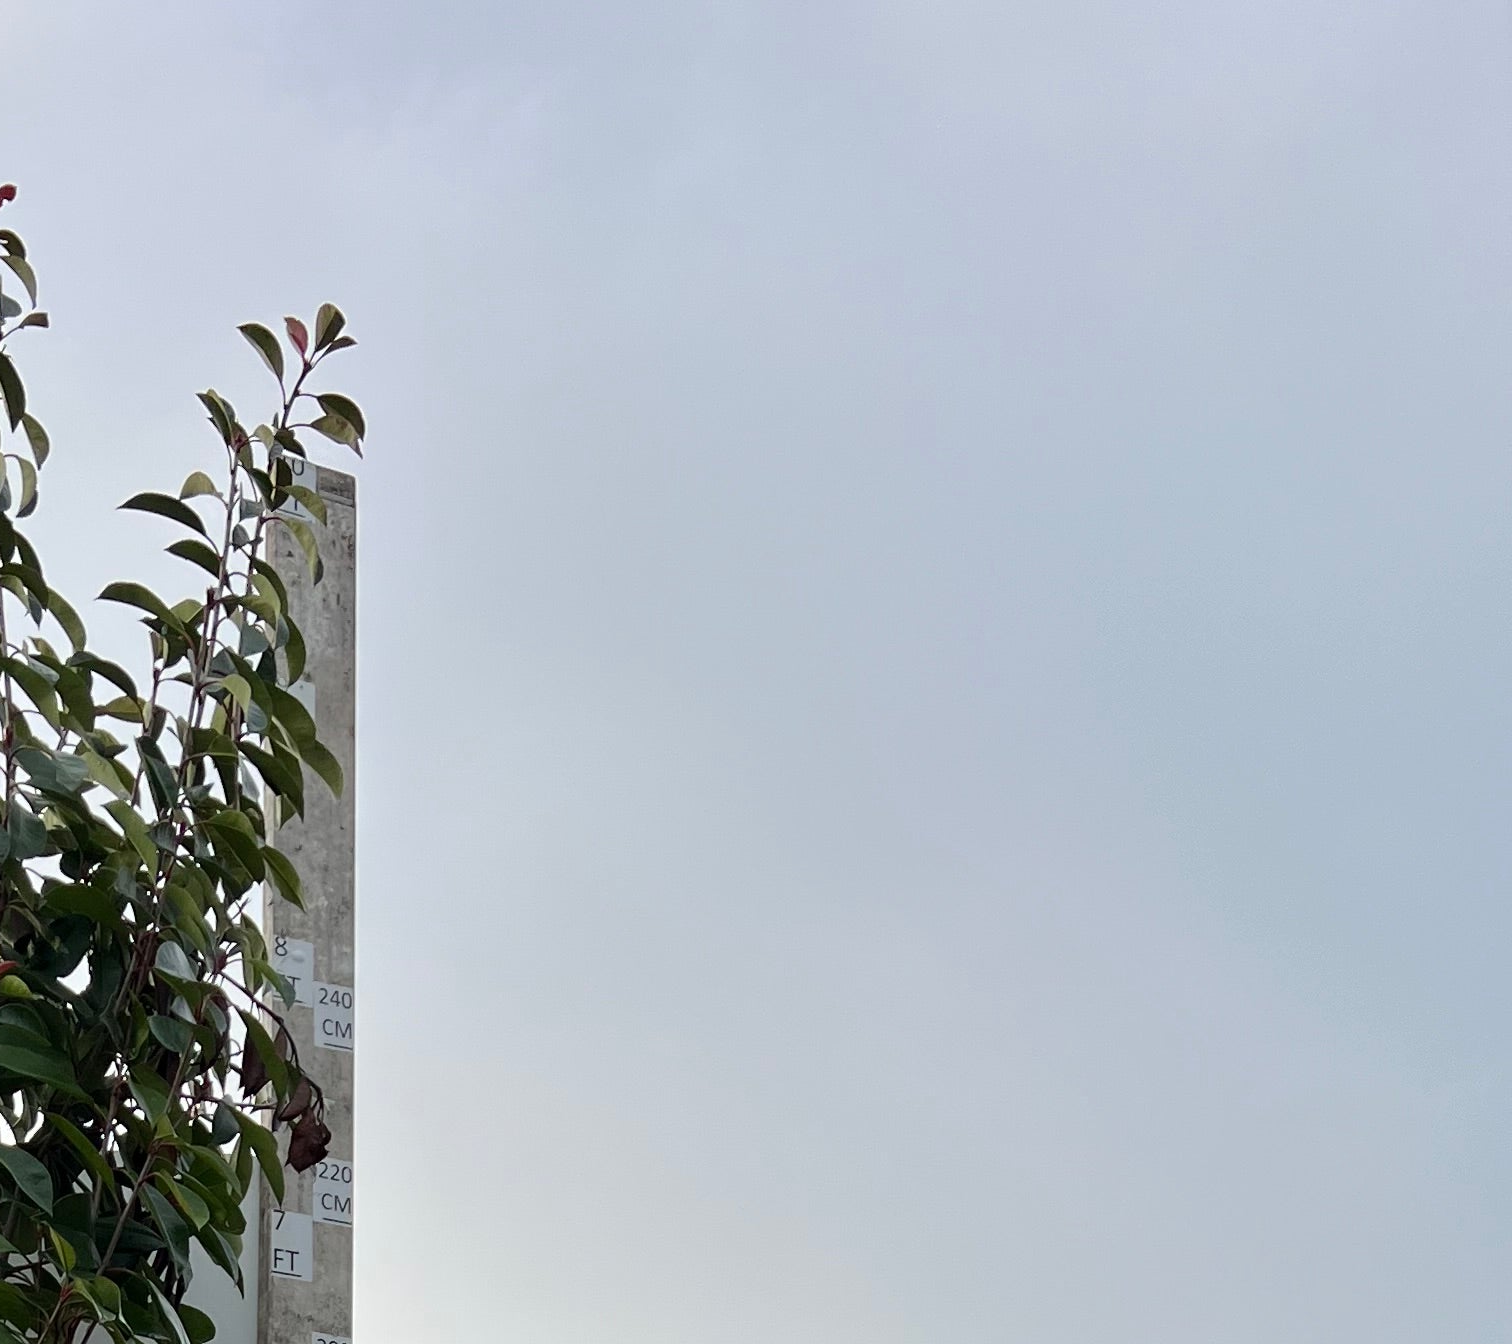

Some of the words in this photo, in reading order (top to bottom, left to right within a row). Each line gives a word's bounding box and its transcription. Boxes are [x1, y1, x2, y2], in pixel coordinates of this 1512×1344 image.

[319, 987, 353, 1010] 240
[322, 1018, 352, 1040] CM
[318, 1161, 352, 1184] 220
[321, 1193, 351, 1215] CM
[273, 1209, 285, 1231] 7
[273, 1248, 299, 1272] FT
